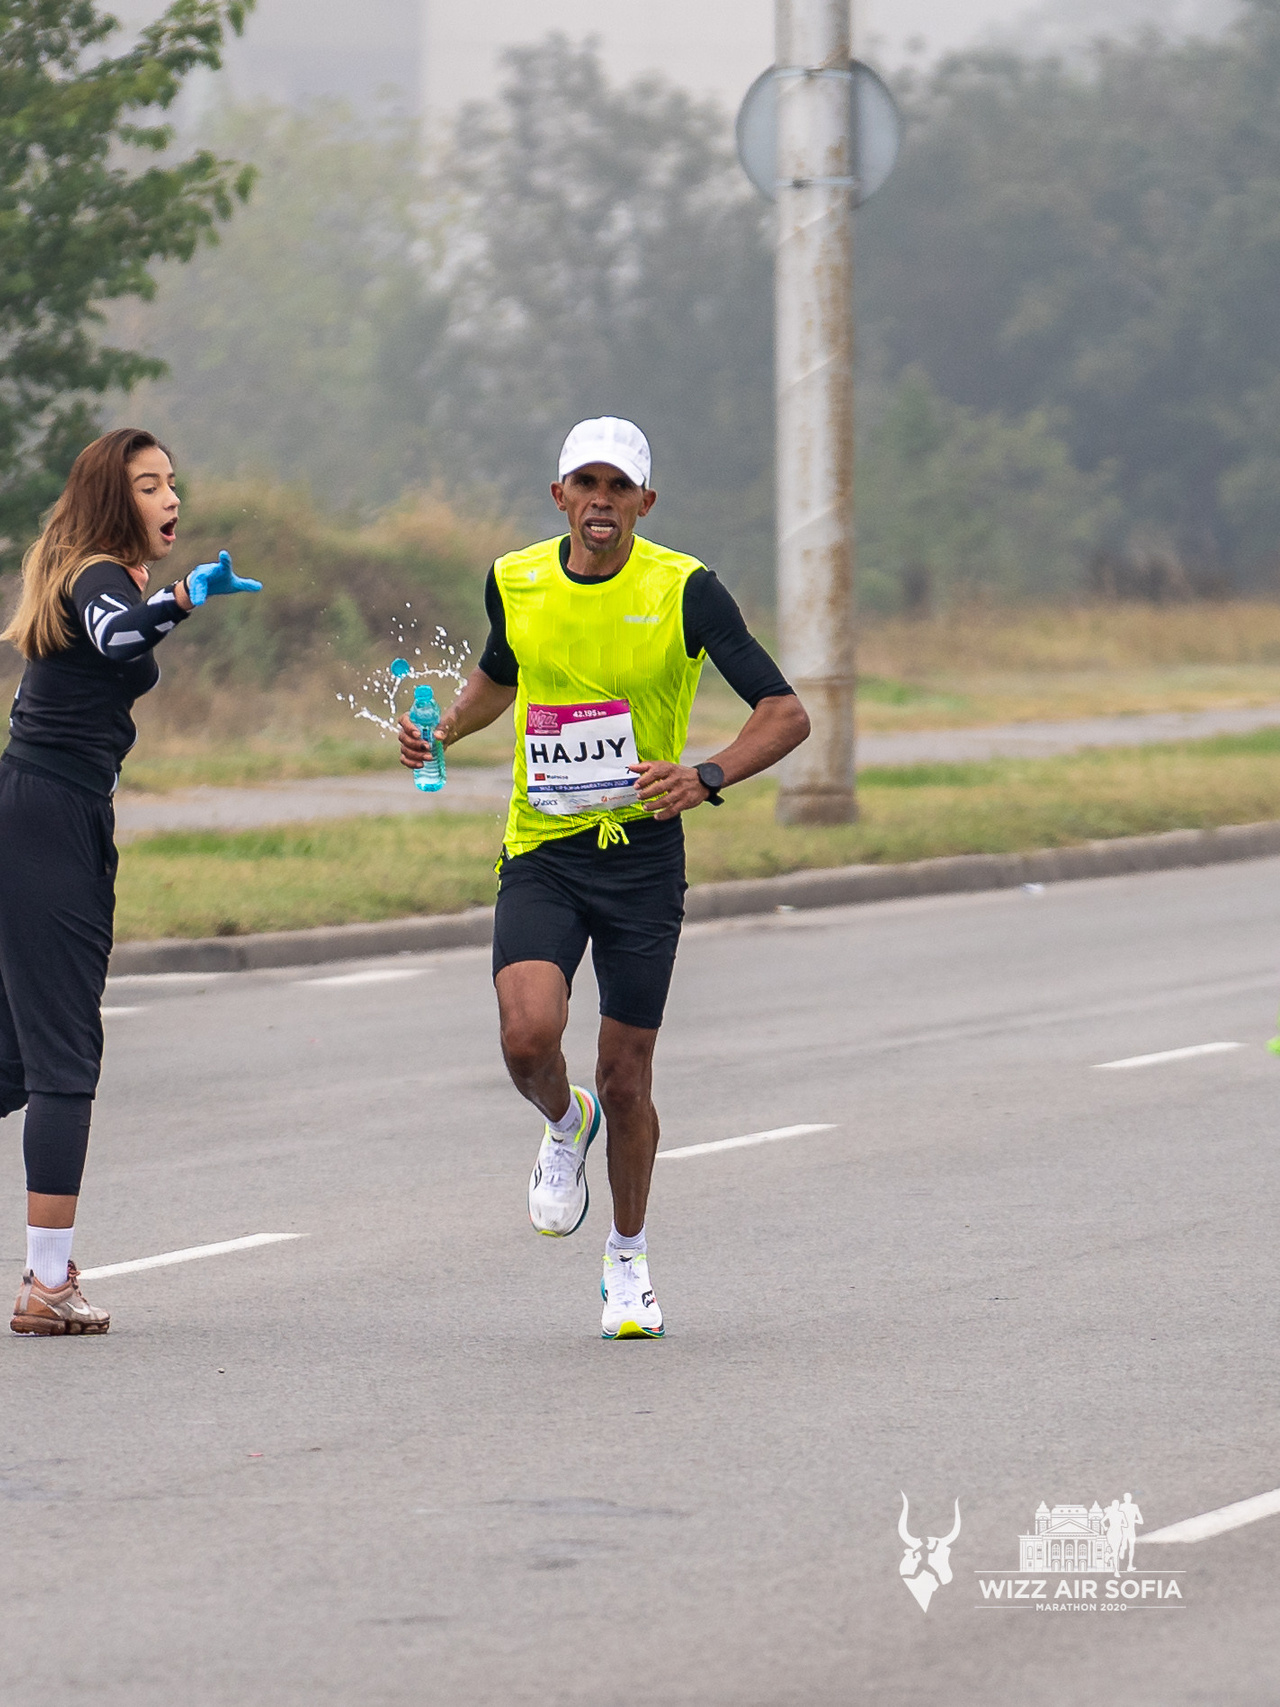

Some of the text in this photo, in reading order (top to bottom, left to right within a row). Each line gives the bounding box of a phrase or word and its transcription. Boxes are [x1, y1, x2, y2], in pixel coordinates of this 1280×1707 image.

[573, 709, 597, 718] 42.195
[530, 737, 627, 763] HAJJY
[614, 779, 629, 787] 2020
